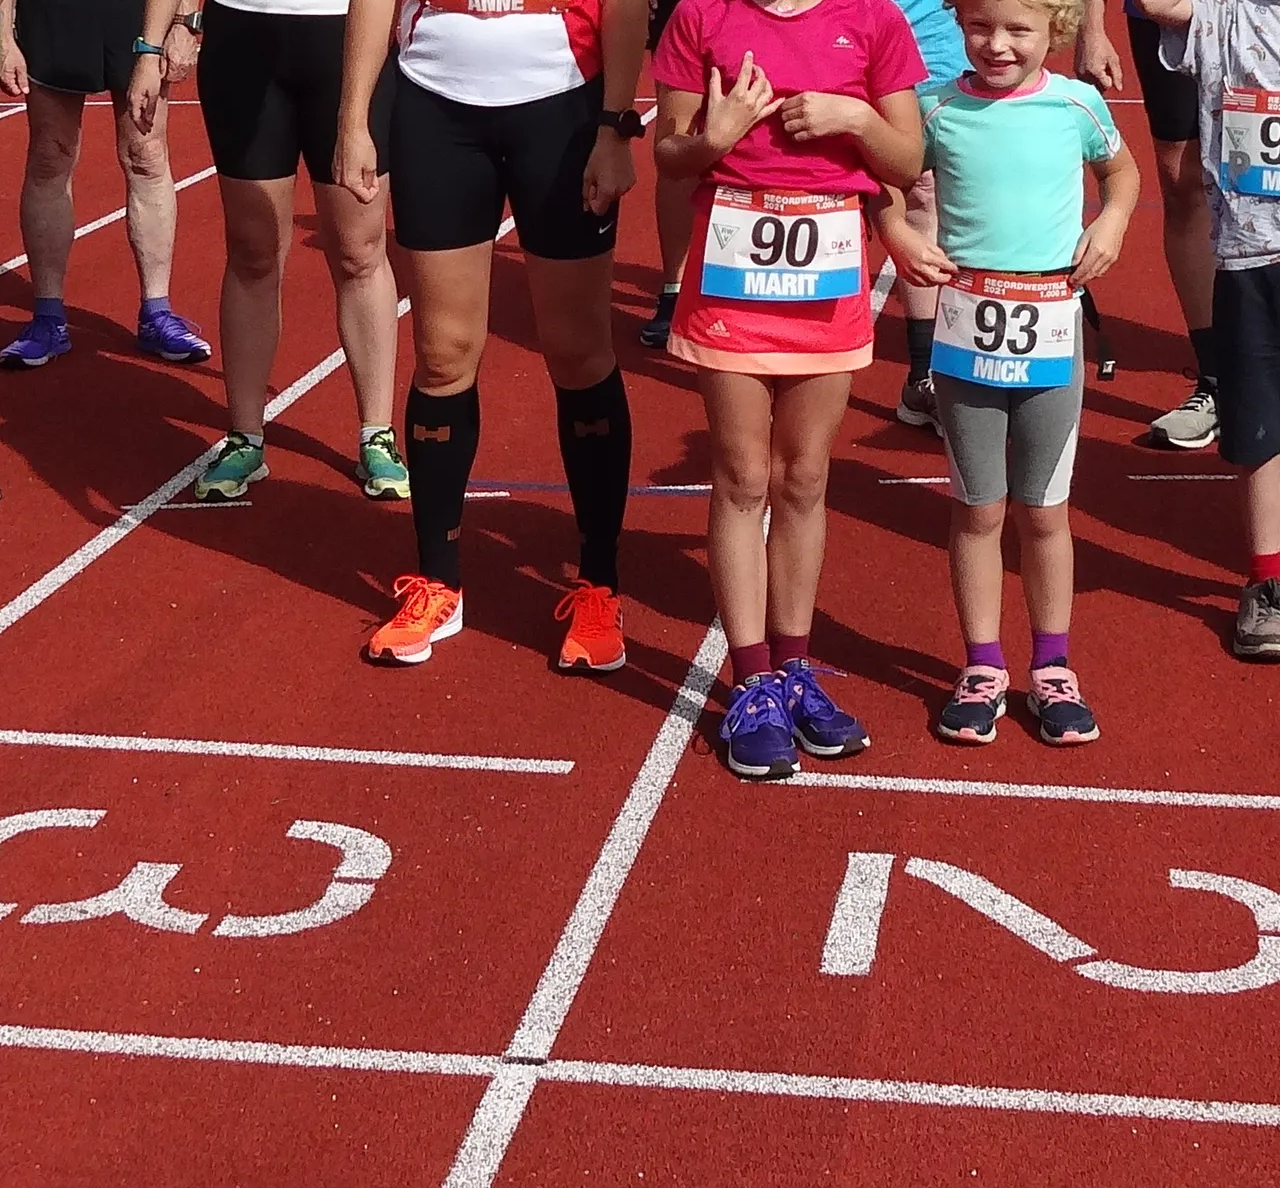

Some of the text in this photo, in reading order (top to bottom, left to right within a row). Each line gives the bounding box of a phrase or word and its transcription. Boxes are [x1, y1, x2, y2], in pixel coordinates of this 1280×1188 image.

[764, 202, 785, 212] 2021
[749, 216, 819, 268] 90
[744, 272, 819, 296] MARIT
[984, 286, 1006, 295] 2021
[973, 299, 1040, 355] 93
[973, 355, 1031, 383] MICK
